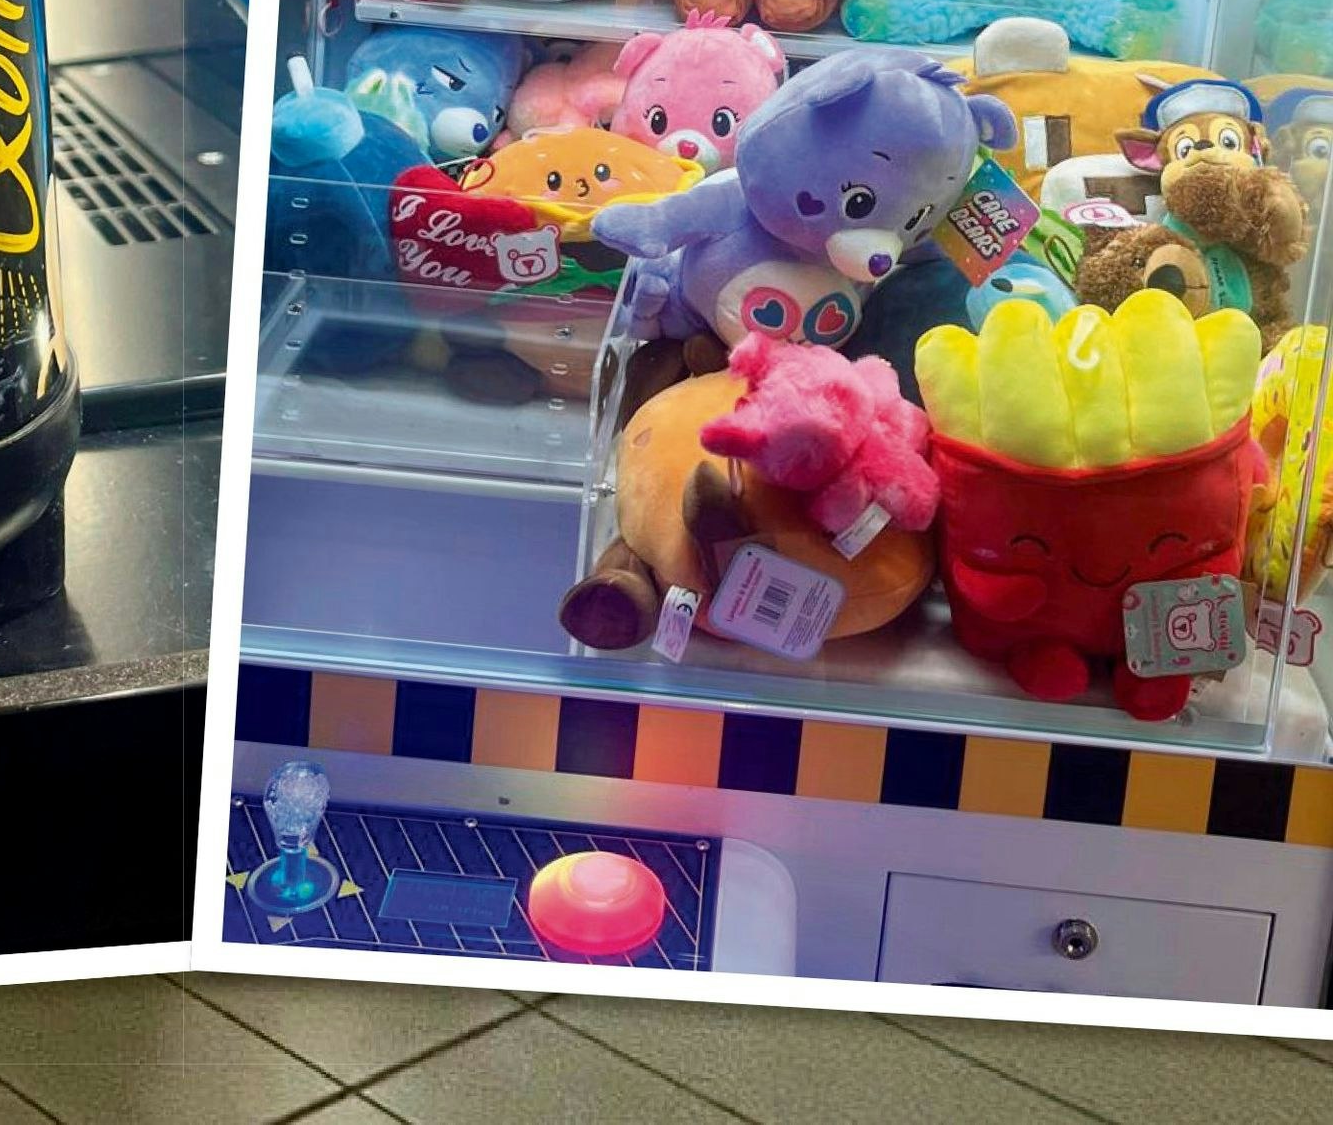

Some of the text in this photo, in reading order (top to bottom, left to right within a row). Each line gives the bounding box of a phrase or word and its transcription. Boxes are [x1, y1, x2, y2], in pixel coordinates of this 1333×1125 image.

[949, 207, 1003, 257] BEARS
[973, 190, 1020, 236] CARE
[397, 238, 472, 287] You
